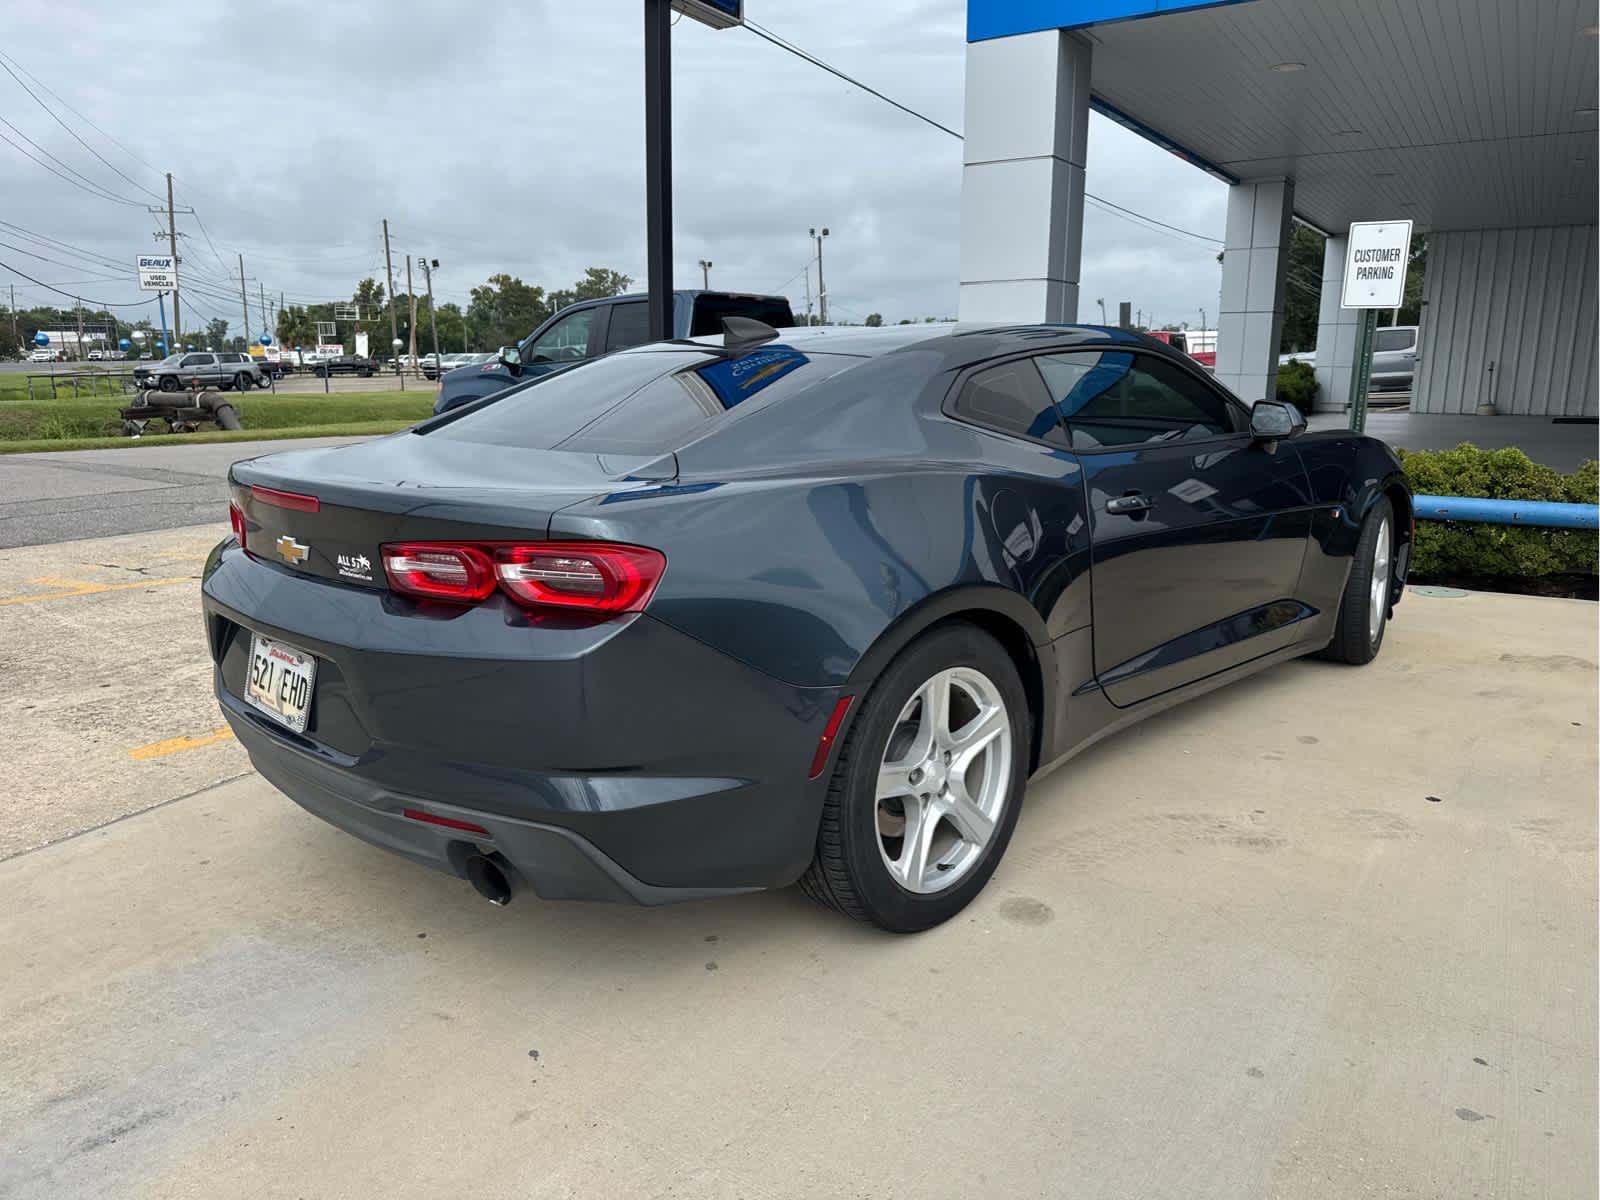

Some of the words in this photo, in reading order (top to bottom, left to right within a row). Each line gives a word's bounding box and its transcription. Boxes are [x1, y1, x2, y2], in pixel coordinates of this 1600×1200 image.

[1354, 248, 1401, 263] CUSTOMER
[140, 259, 172, 267] GEAUX
[1356, 266, 1394, 280] PARKING
[337, 554, 351, 567] ALL
[253, 654, 275, 693] 521
[281, 668, 308, 710] EHD
